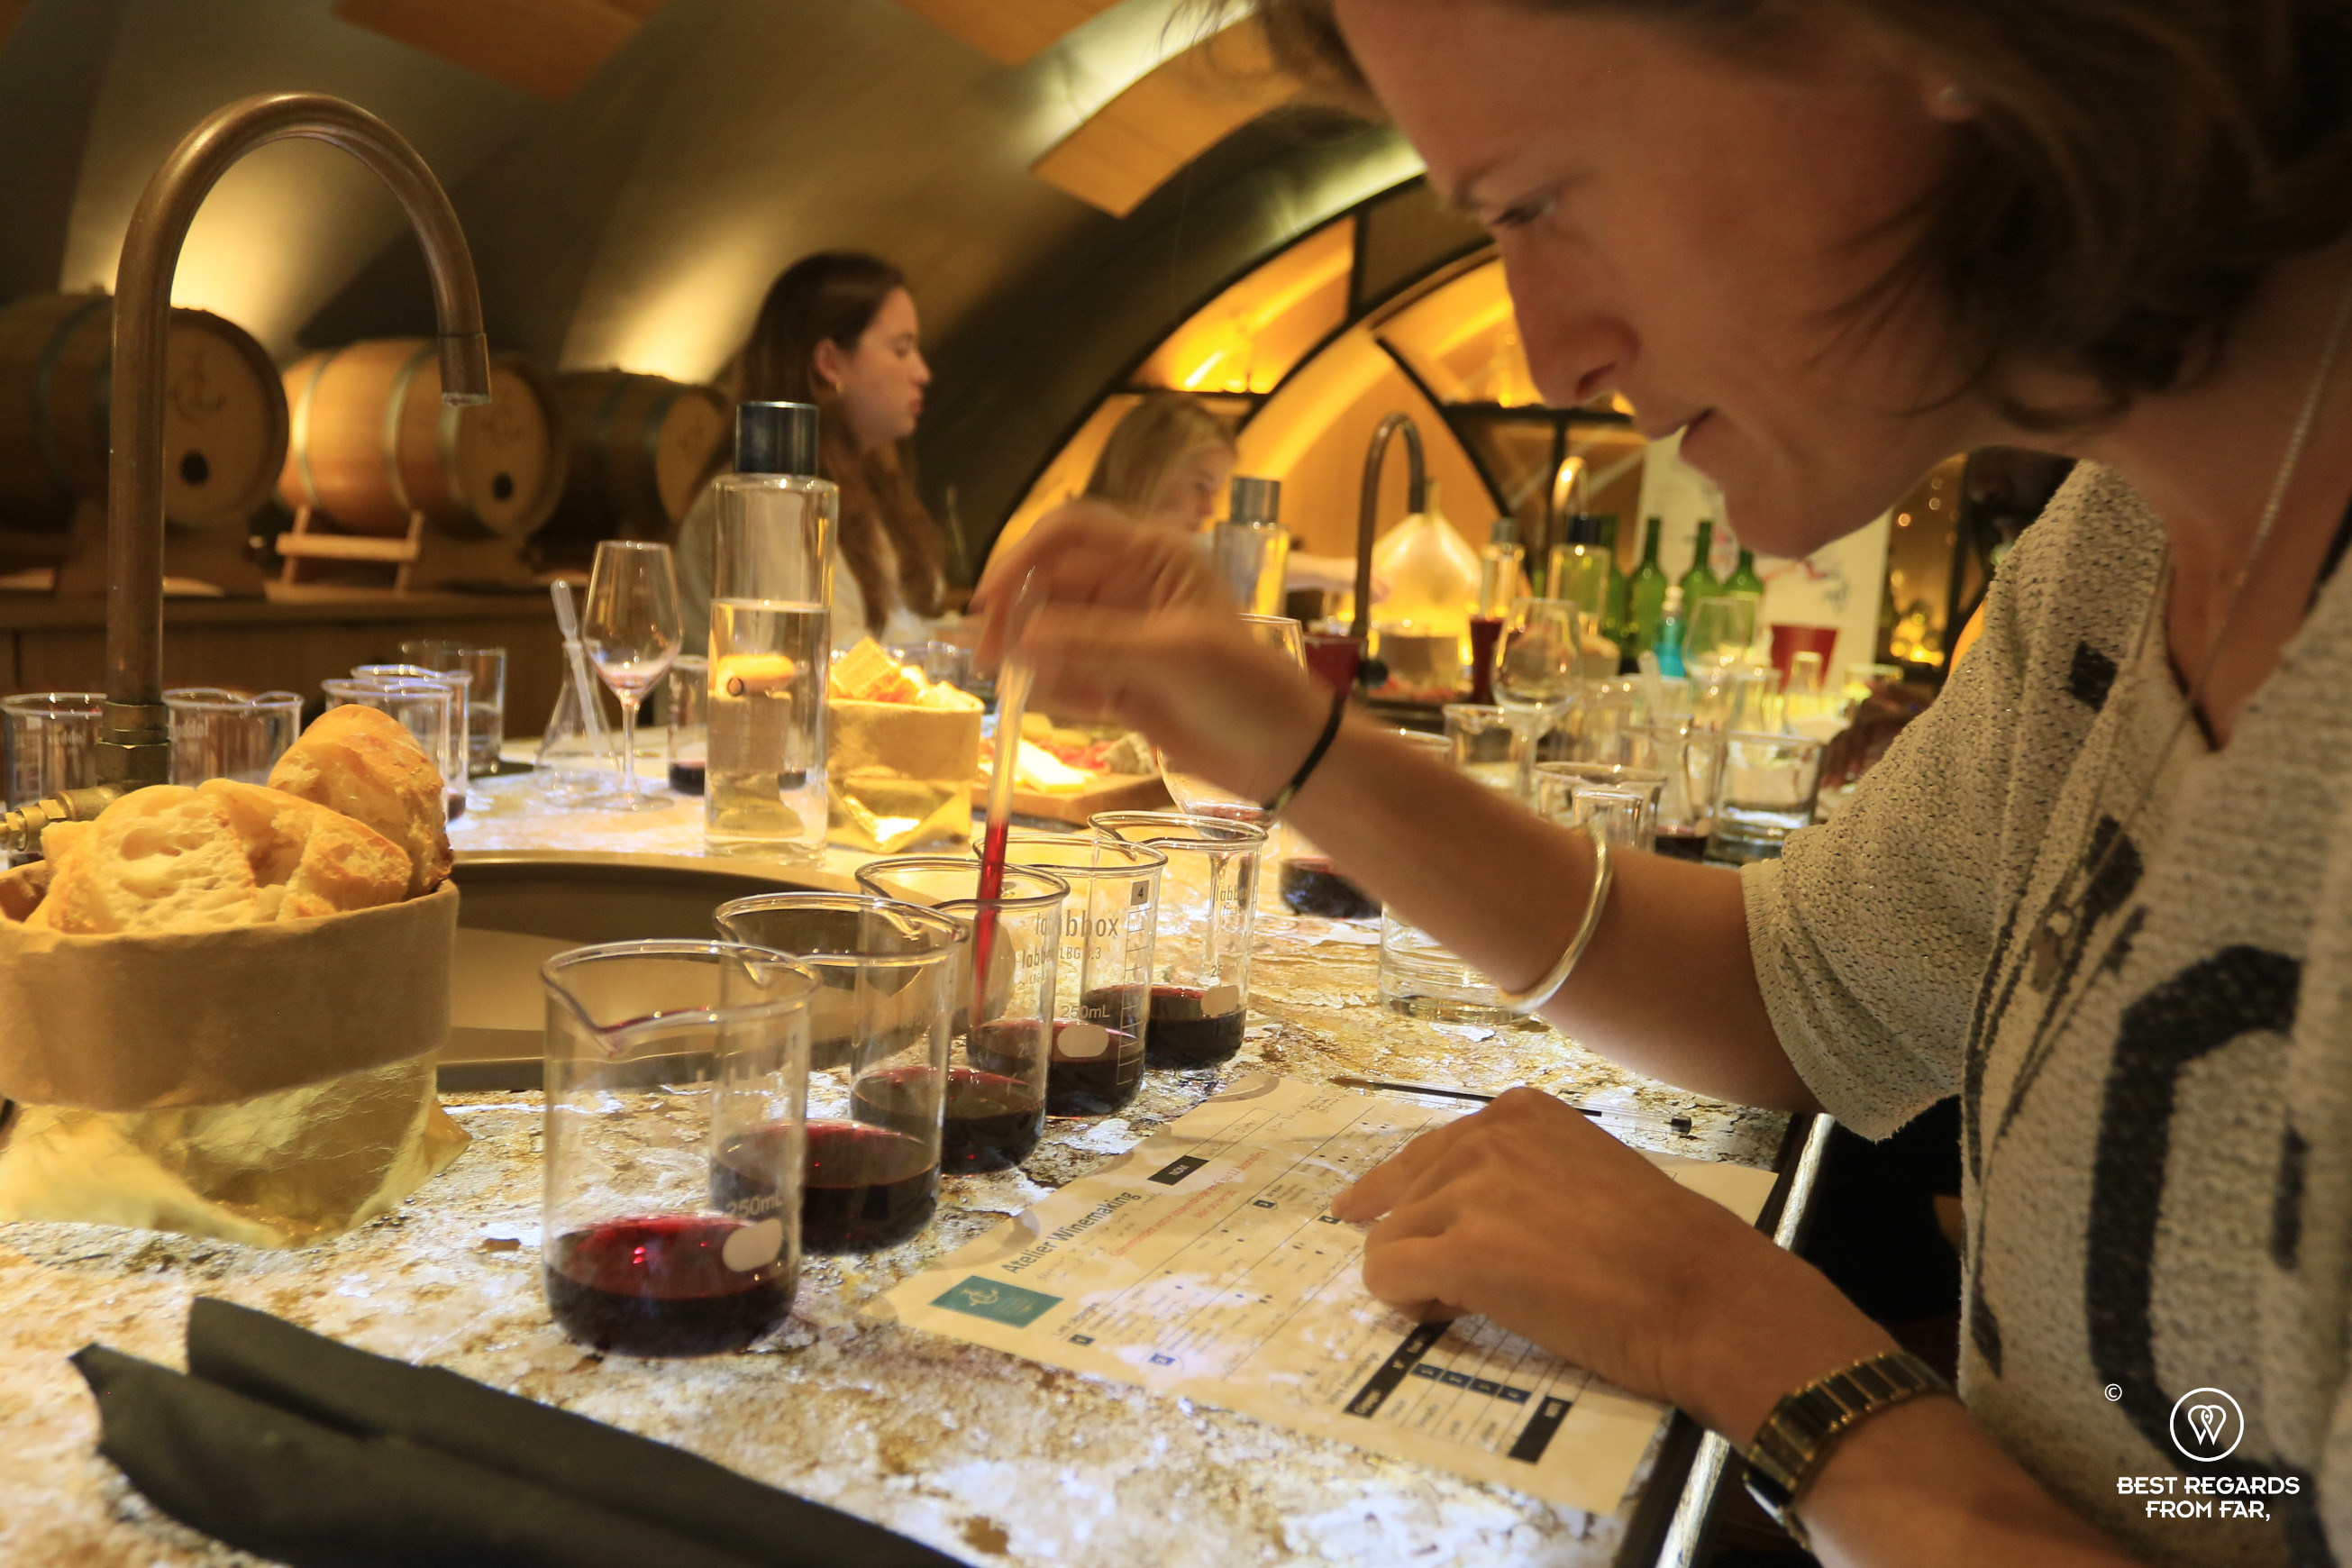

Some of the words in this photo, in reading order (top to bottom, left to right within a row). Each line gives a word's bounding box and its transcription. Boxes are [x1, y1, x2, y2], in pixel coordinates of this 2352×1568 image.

[1137, 887, 1144, 898] 4
[1060, 946, 1080, 959] LBG
[1061, 1005, 1111, 1019] 250mL
[1169, 1164, 1190, 1177] NOM
[725, 1190, 782, 1216] 250mL
[1001, 1242, 1058, 1274] Atelier
[1046, 1191, 1142, 1242] Winemaking
